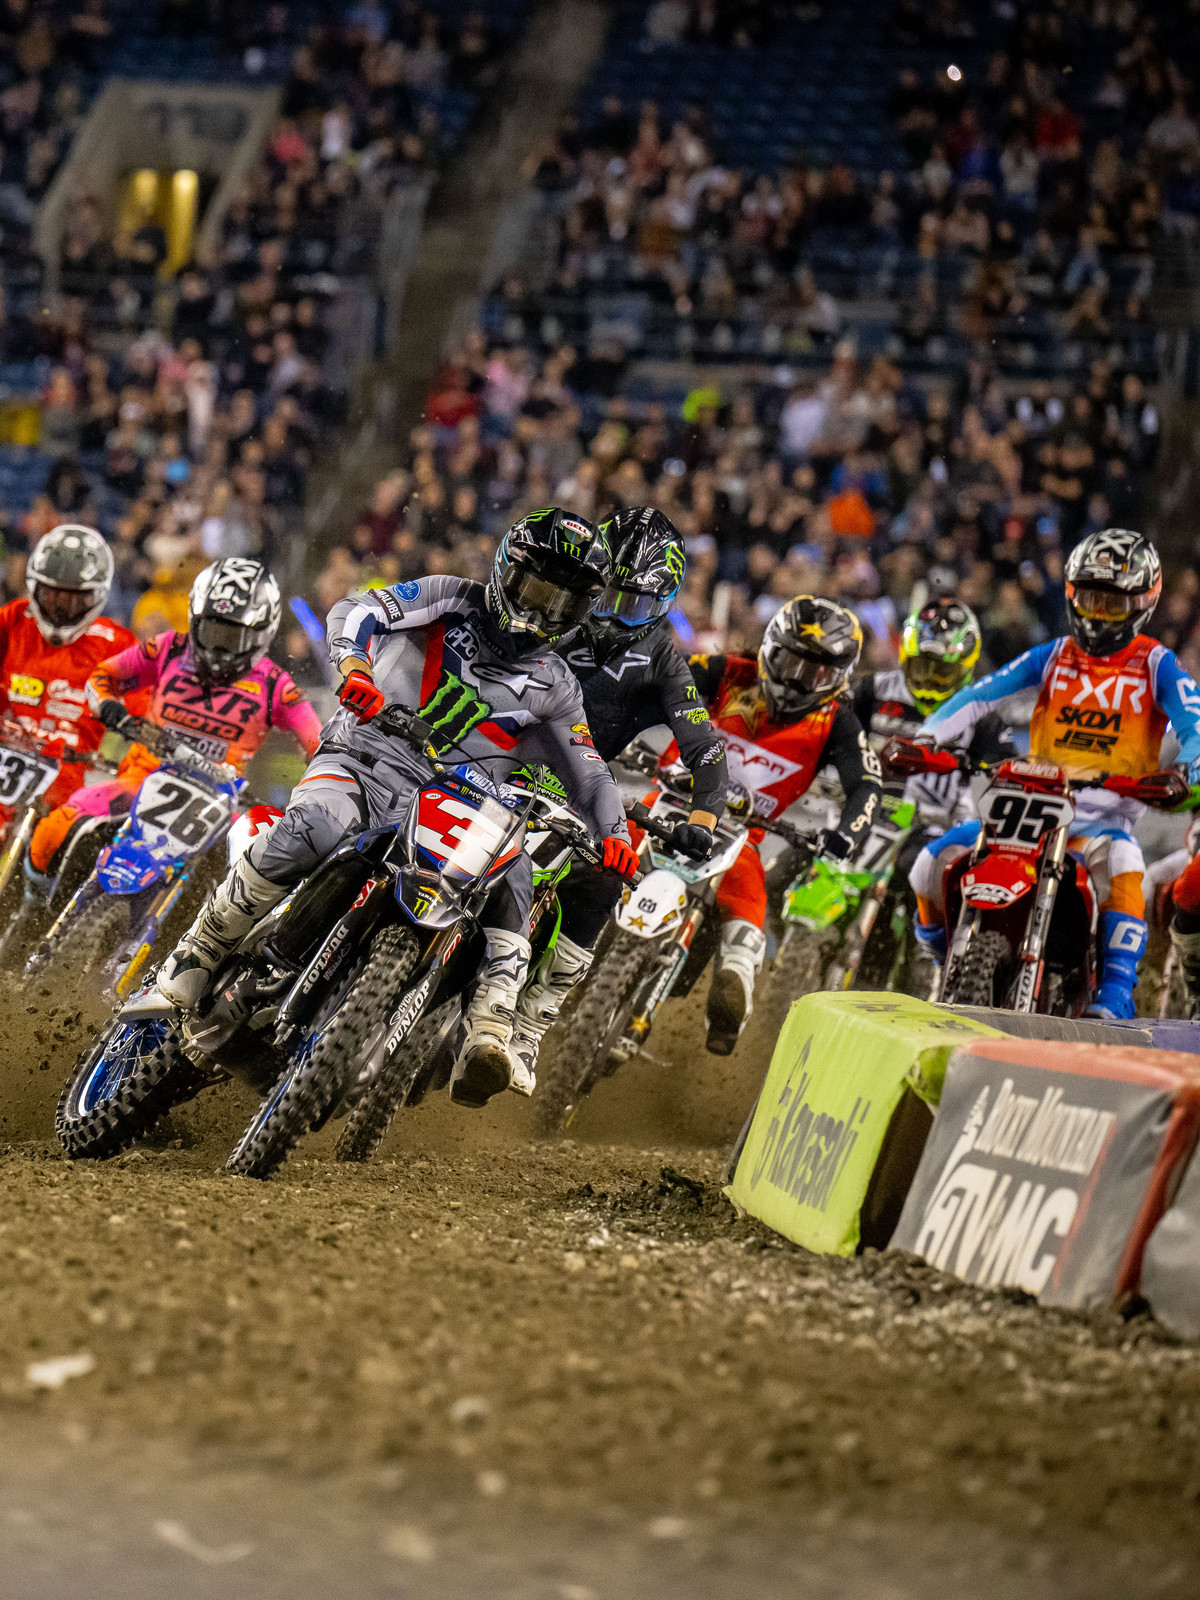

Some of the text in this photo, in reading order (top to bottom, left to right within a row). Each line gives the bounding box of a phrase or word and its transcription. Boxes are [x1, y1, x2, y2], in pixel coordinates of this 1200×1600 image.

[566, 521, 588, 535] BELL
[447, 628, 478, 658] PPG
[161, 674, 261, 723] FXR
[1050, 665, 1147, 714] FXR
[163, 706, 239, 739] MOTO
[1055, 706, 1122, 733] SKDA
[138, 782, 222, 846] 26
[415, 798, 516, 877] 3
[989, 795, 1065, 843] 95
[302, 924, 349, 995] DUNLOP
[386, 981, 431, 1054] DUNLOP
